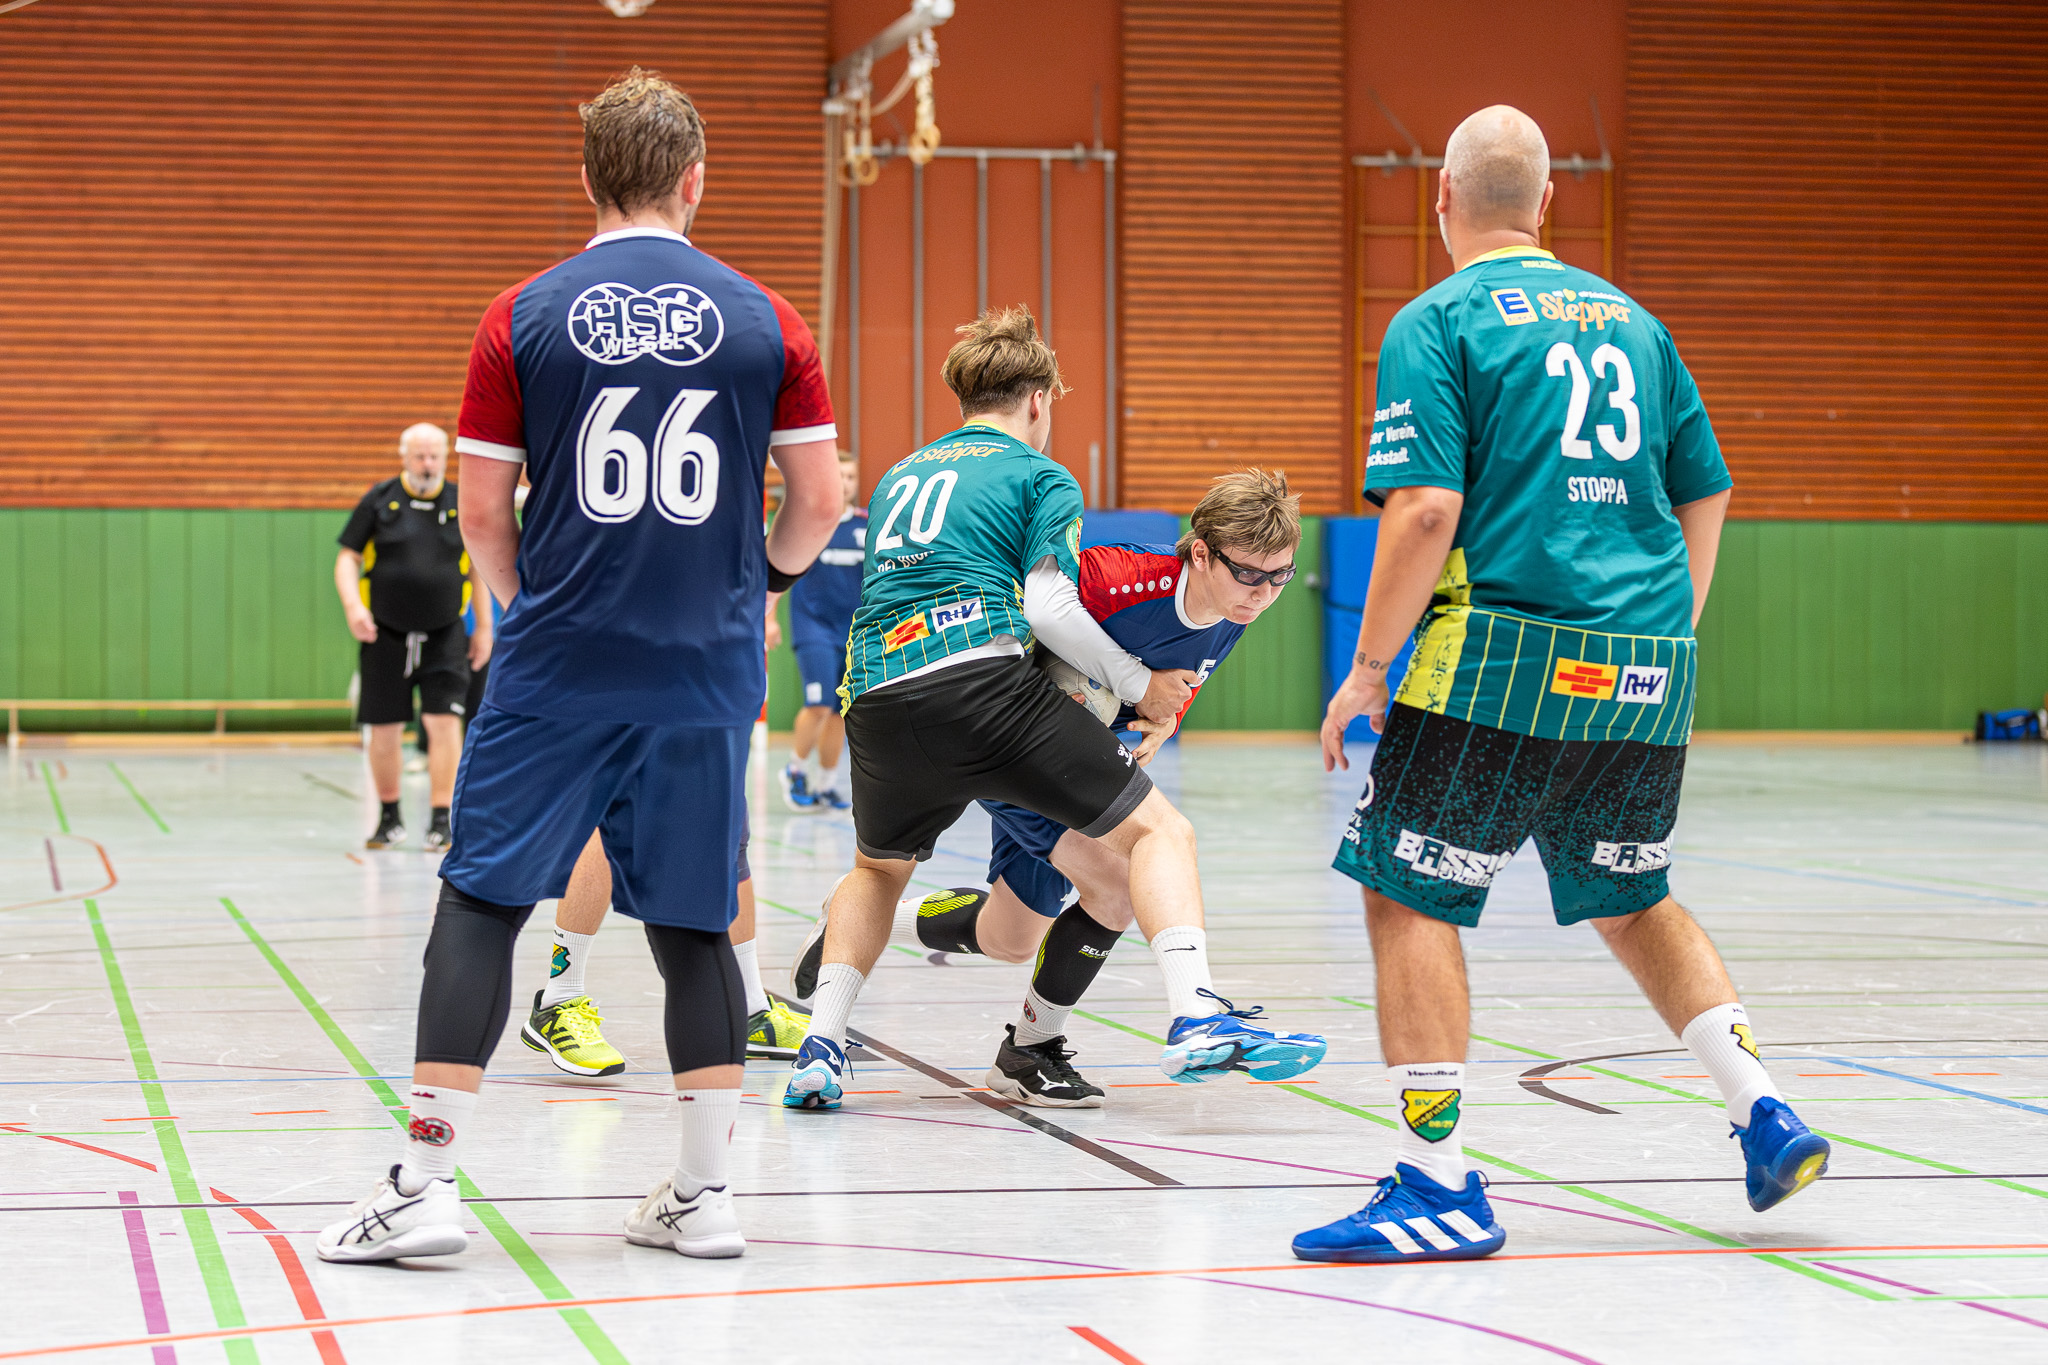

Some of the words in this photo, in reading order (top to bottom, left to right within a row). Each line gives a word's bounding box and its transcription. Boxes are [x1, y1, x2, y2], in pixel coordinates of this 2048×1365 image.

[589, 296, 703, 341] HSG
[1536, 292, 1632, 332] Stepper
[600, 333, 685, 356] WESEL
[1545, 341, 1642, 461] 23
[576, 386, 720, 525] 66
[914, 446, 1004, 464] Stepper
[1567, 475, 1629, 505] STOPPA
[874, 470, 959, 555] 20
[936, 601, 977, 627] R+V
[1623, 673, 1664, 696] R+V
